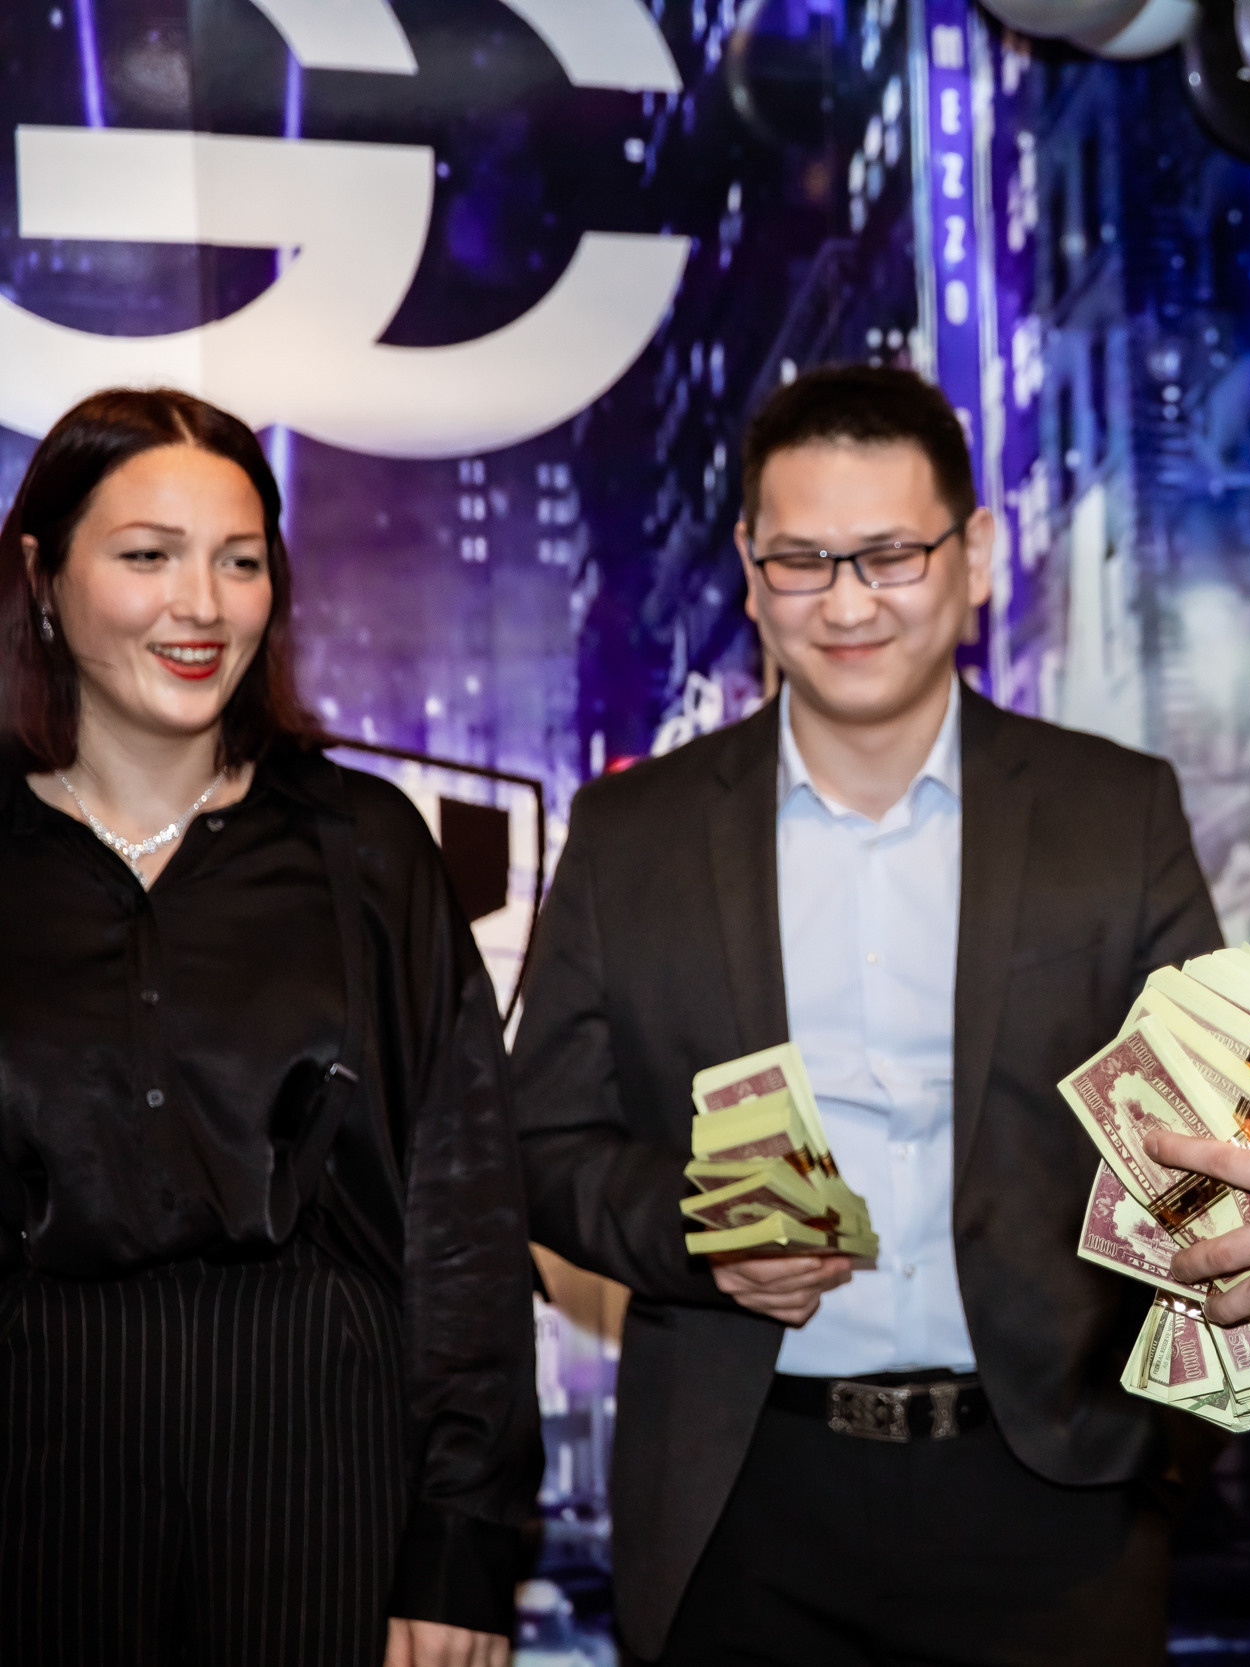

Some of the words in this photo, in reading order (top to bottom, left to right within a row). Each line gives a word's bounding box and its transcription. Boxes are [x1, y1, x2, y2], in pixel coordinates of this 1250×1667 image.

[1150, 1076, 1168, 1099] THE
[1166, 1094, 1197, 1127] UNITED
[1085, 1233, 1118, 1257] 10000
[1179, 1339, 1202, 1379] 10000
